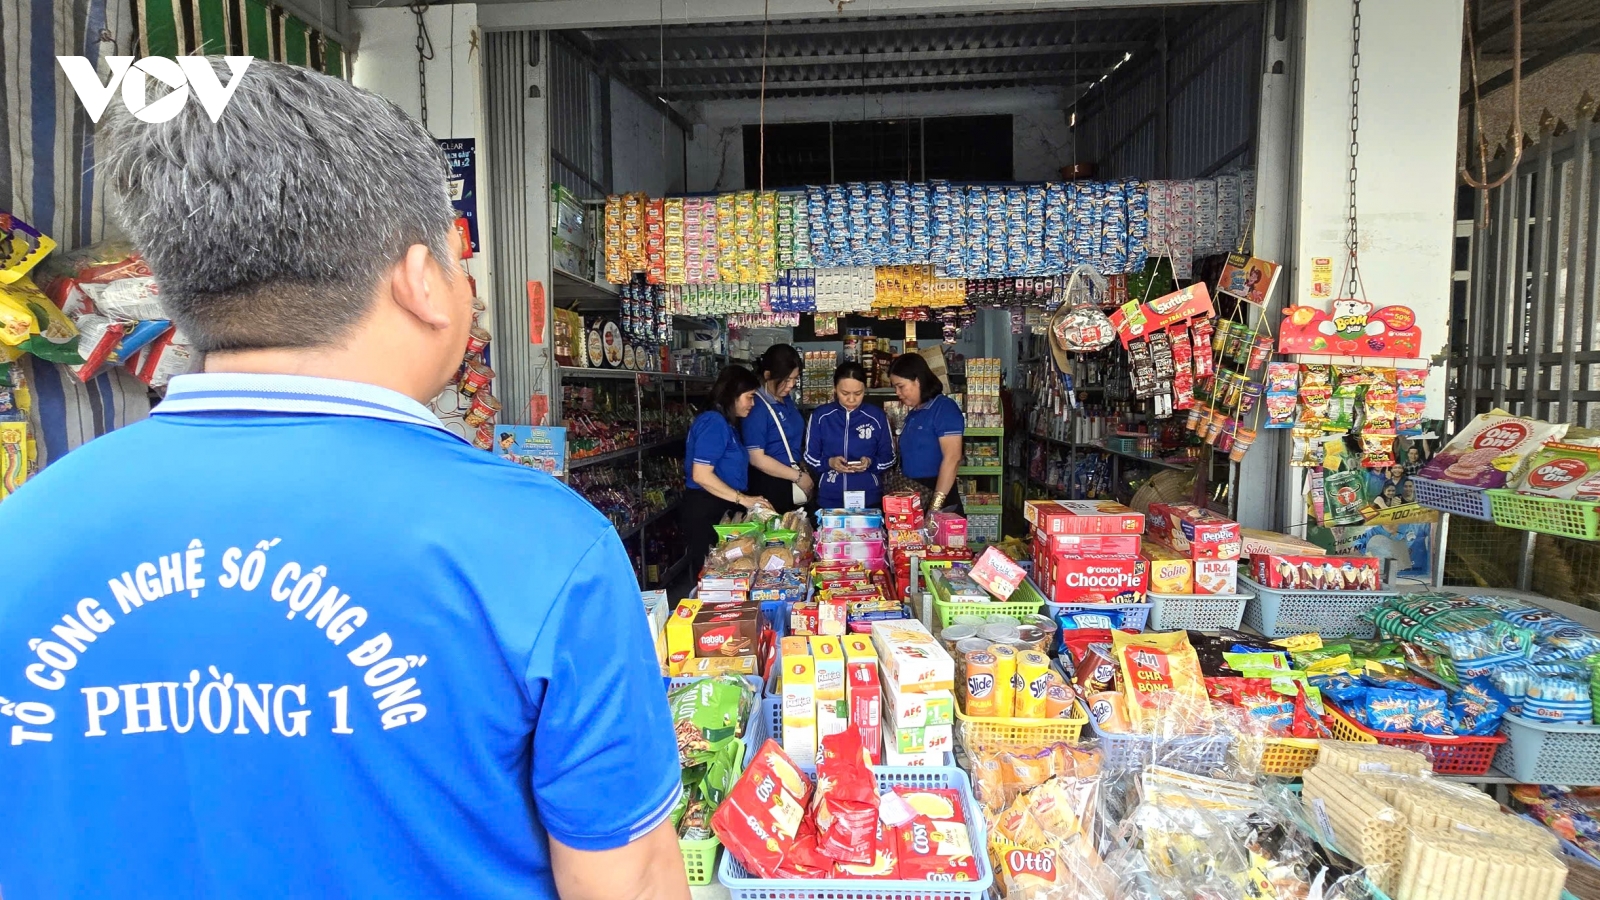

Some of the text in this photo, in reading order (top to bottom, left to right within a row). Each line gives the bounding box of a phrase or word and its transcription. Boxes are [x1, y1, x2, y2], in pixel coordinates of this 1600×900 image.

[440, 142, 463, 151] CLEAR
[1156, 292, 1194, 314] Skittles
[1334, 315, 1368, 332] BOOM
[1486, 428, 1520, 439] One
[1480, 437, 1515, 448] One
[1538, 466, 1568, 476] One
[1543, 472, 1574, 482] One
[1391, 509, 1410, 521] 100
[1202, 530, 1234, 543] PepPie
[1244, 543, 1272, 554] Solite
[1159, 565, 1187, 579] Solite
[1203, 563, 1228, 574] HURA
[1066, 572, 1142, 587] ChocoPie
[0, 537, 428, 746] TỔ CÔNG NGHỆ SỐ CỘNG ĐỒNG
[918, 669, 935, 682] AFC
[1096, 665, 1115, 680] Slid
[1467, 666, 1491, 677] Oishi
[968, 676, 991, 697] Slide
[1030, 675, 1048, 698] Slid
[81, 665, 355, 737] PHƯỜNG 1
[903, 706, 922, 718] AFC
[1537, 708, 1563, 718] Oishi
[929, 736, 947, 748] AFC
[755, 774, 777, 803] COSY
[747, 815, 770, 842] COSY
[913, 822, 930, 854] COSY
[1010, 849, 1056, 873] Otto
[926, 872, 954, 882] COSY
